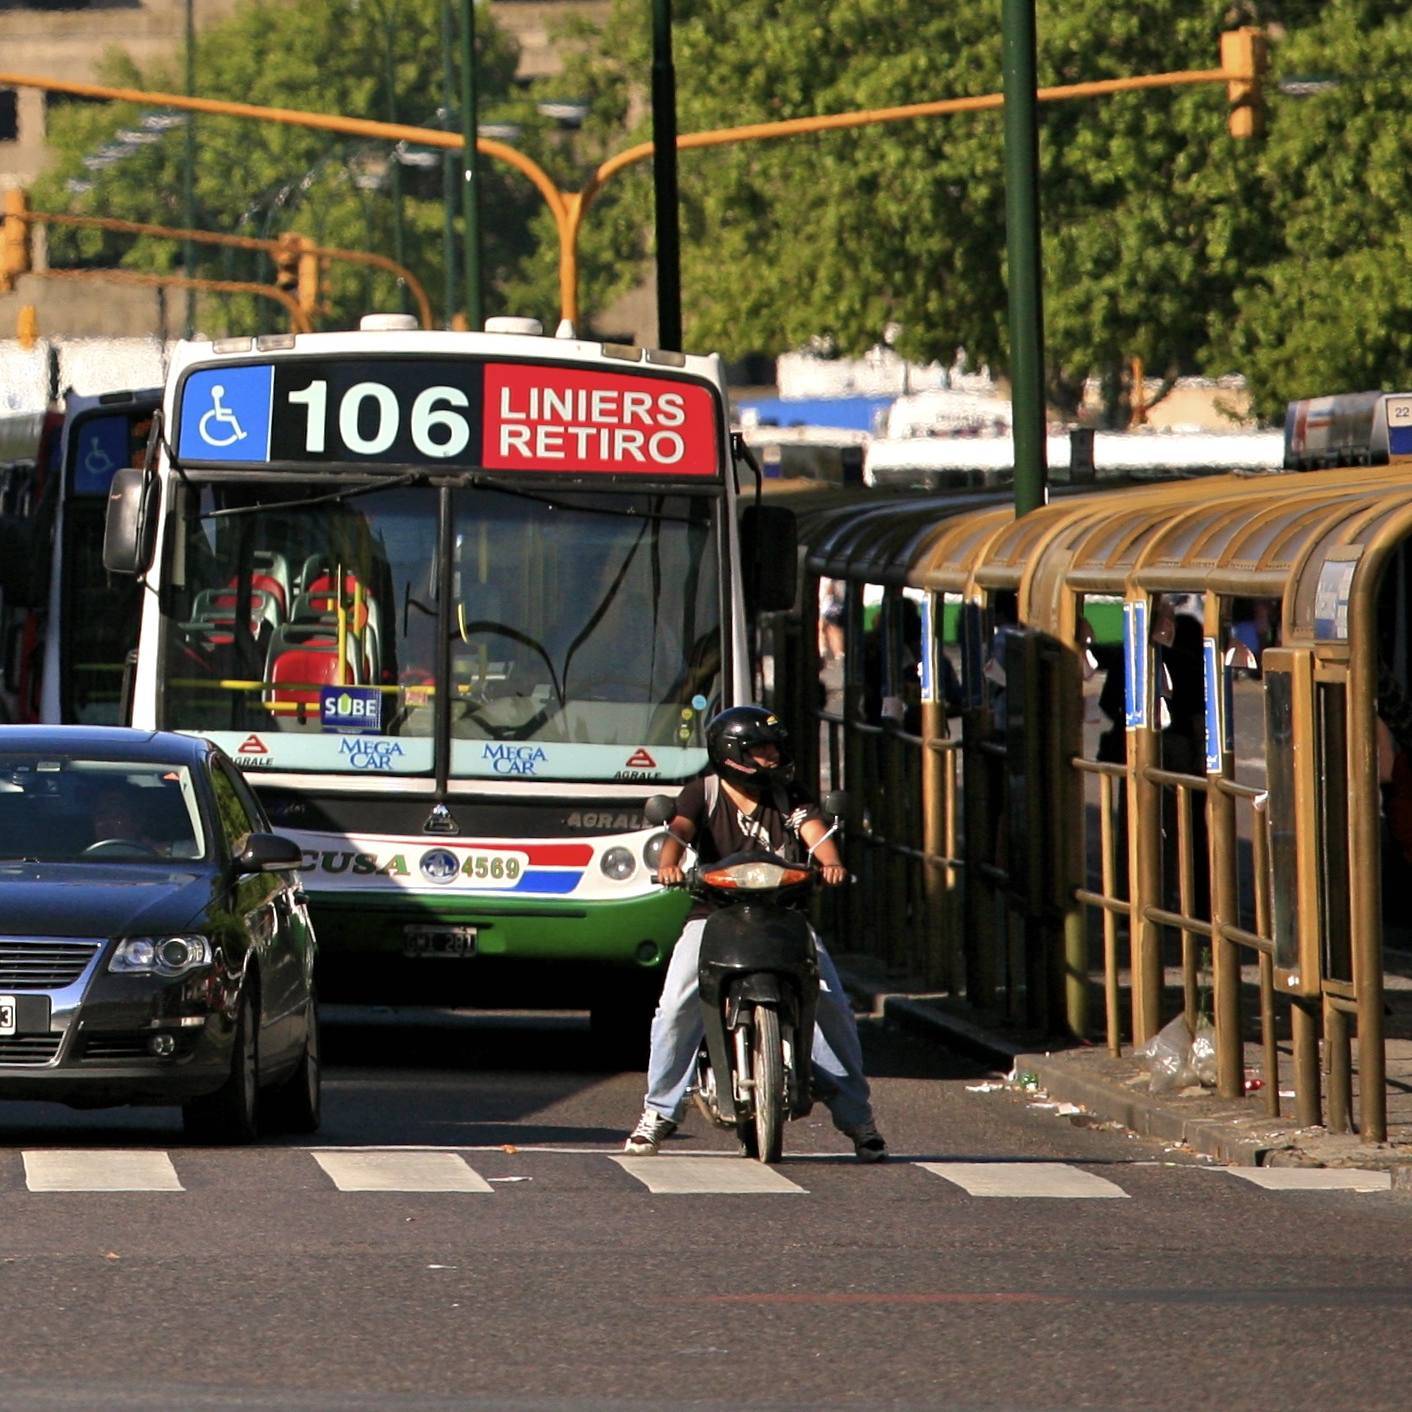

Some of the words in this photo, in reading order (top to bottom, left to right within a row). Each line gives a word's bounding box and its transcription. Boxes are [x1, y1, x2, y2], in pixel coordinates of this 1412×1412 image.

[287, 379, 470, 457] 106
[500, 387, 686, 426] LINIERS
[500, 424, 685, 463] RETIRO
[325, 693, 377, 716] SUBE
[338, 737, 405, 756] MEGA
[482, 743, 548, 762] MEGA
[350, 754, 392, 770] CAR
[493, 759, 536, 775] CAR
[461, 856, 519, 879] 4569
